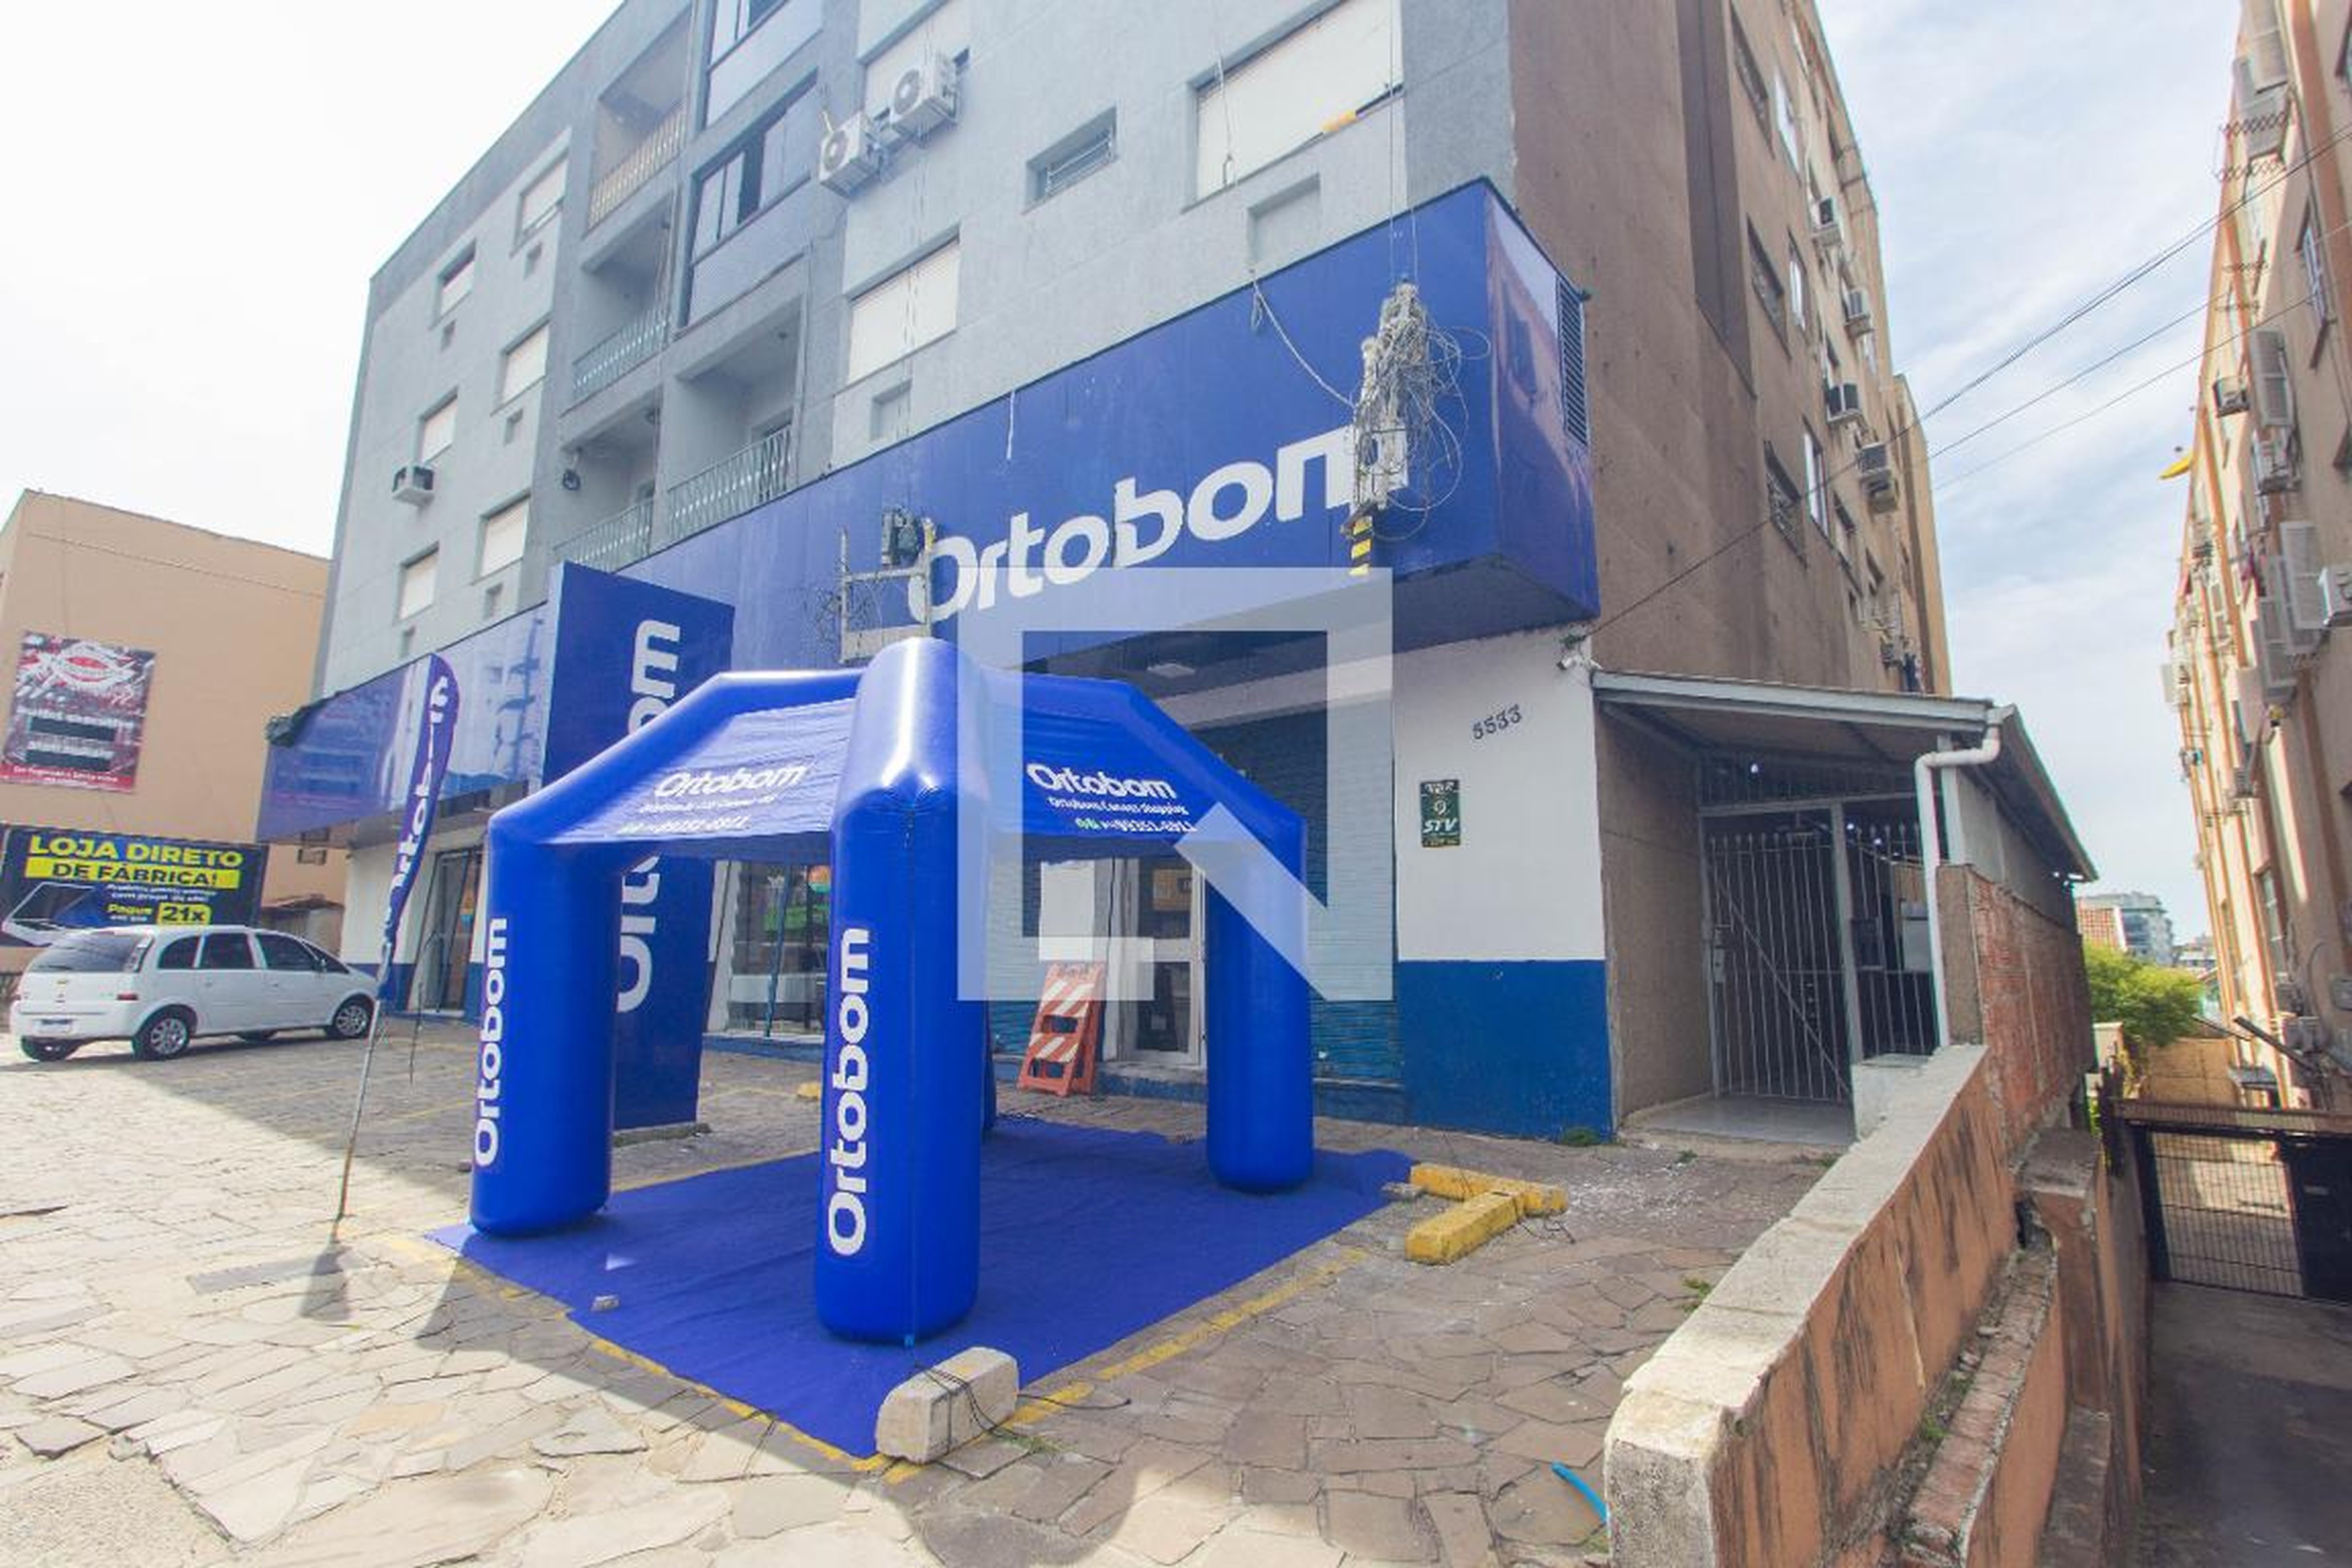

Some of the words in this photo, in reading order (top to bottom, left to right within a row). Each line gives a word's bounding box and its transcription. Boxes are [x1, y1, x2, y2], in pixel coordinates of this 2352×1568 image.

[908, 424, 1407, 624] Ortobom
[655, 766, 807, 797] Ortobom
[1025, 763, 1177, 798] Ortobom
[1423, 818, 1457, 834] STV
[30, 835, 119, 859] LOJA
[127, 843, 243, 867] DIRETO
[53, 862, 89, 881] DE
[107, 903, 153, 916] Pague
[163, 906, 205, 922] 21x
[475, 918, 507, 1167] Ortobom
[829, 927, 869, 1256] Ortobom
